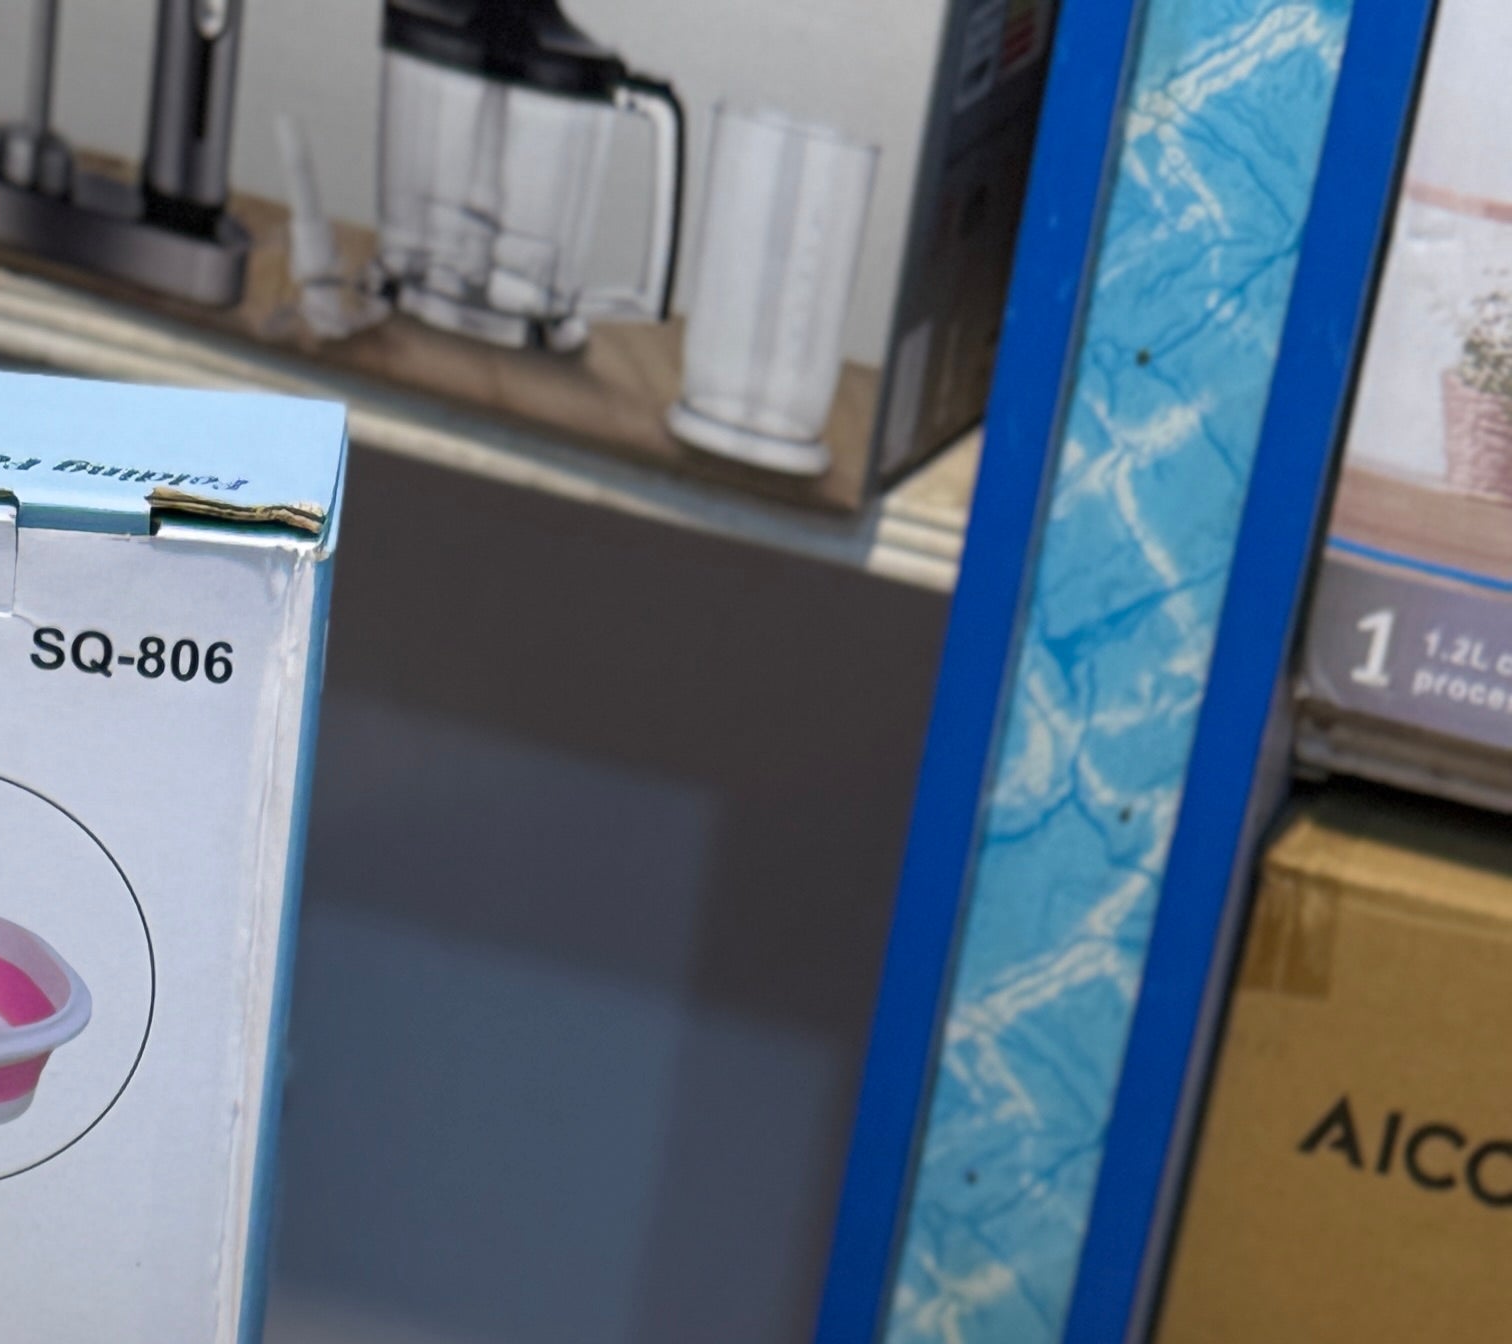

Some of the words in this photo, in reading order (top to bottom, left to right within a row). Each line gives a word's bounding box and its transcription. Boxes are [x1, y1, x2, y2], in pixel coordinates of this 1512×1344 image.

[30, 627, 234, 685] SQ-806
[1350, 609, 1394, 686] 1
[1424, 628, 1488, 672] 1.2L
[1297, 1092, 1512, 1210] AICO
